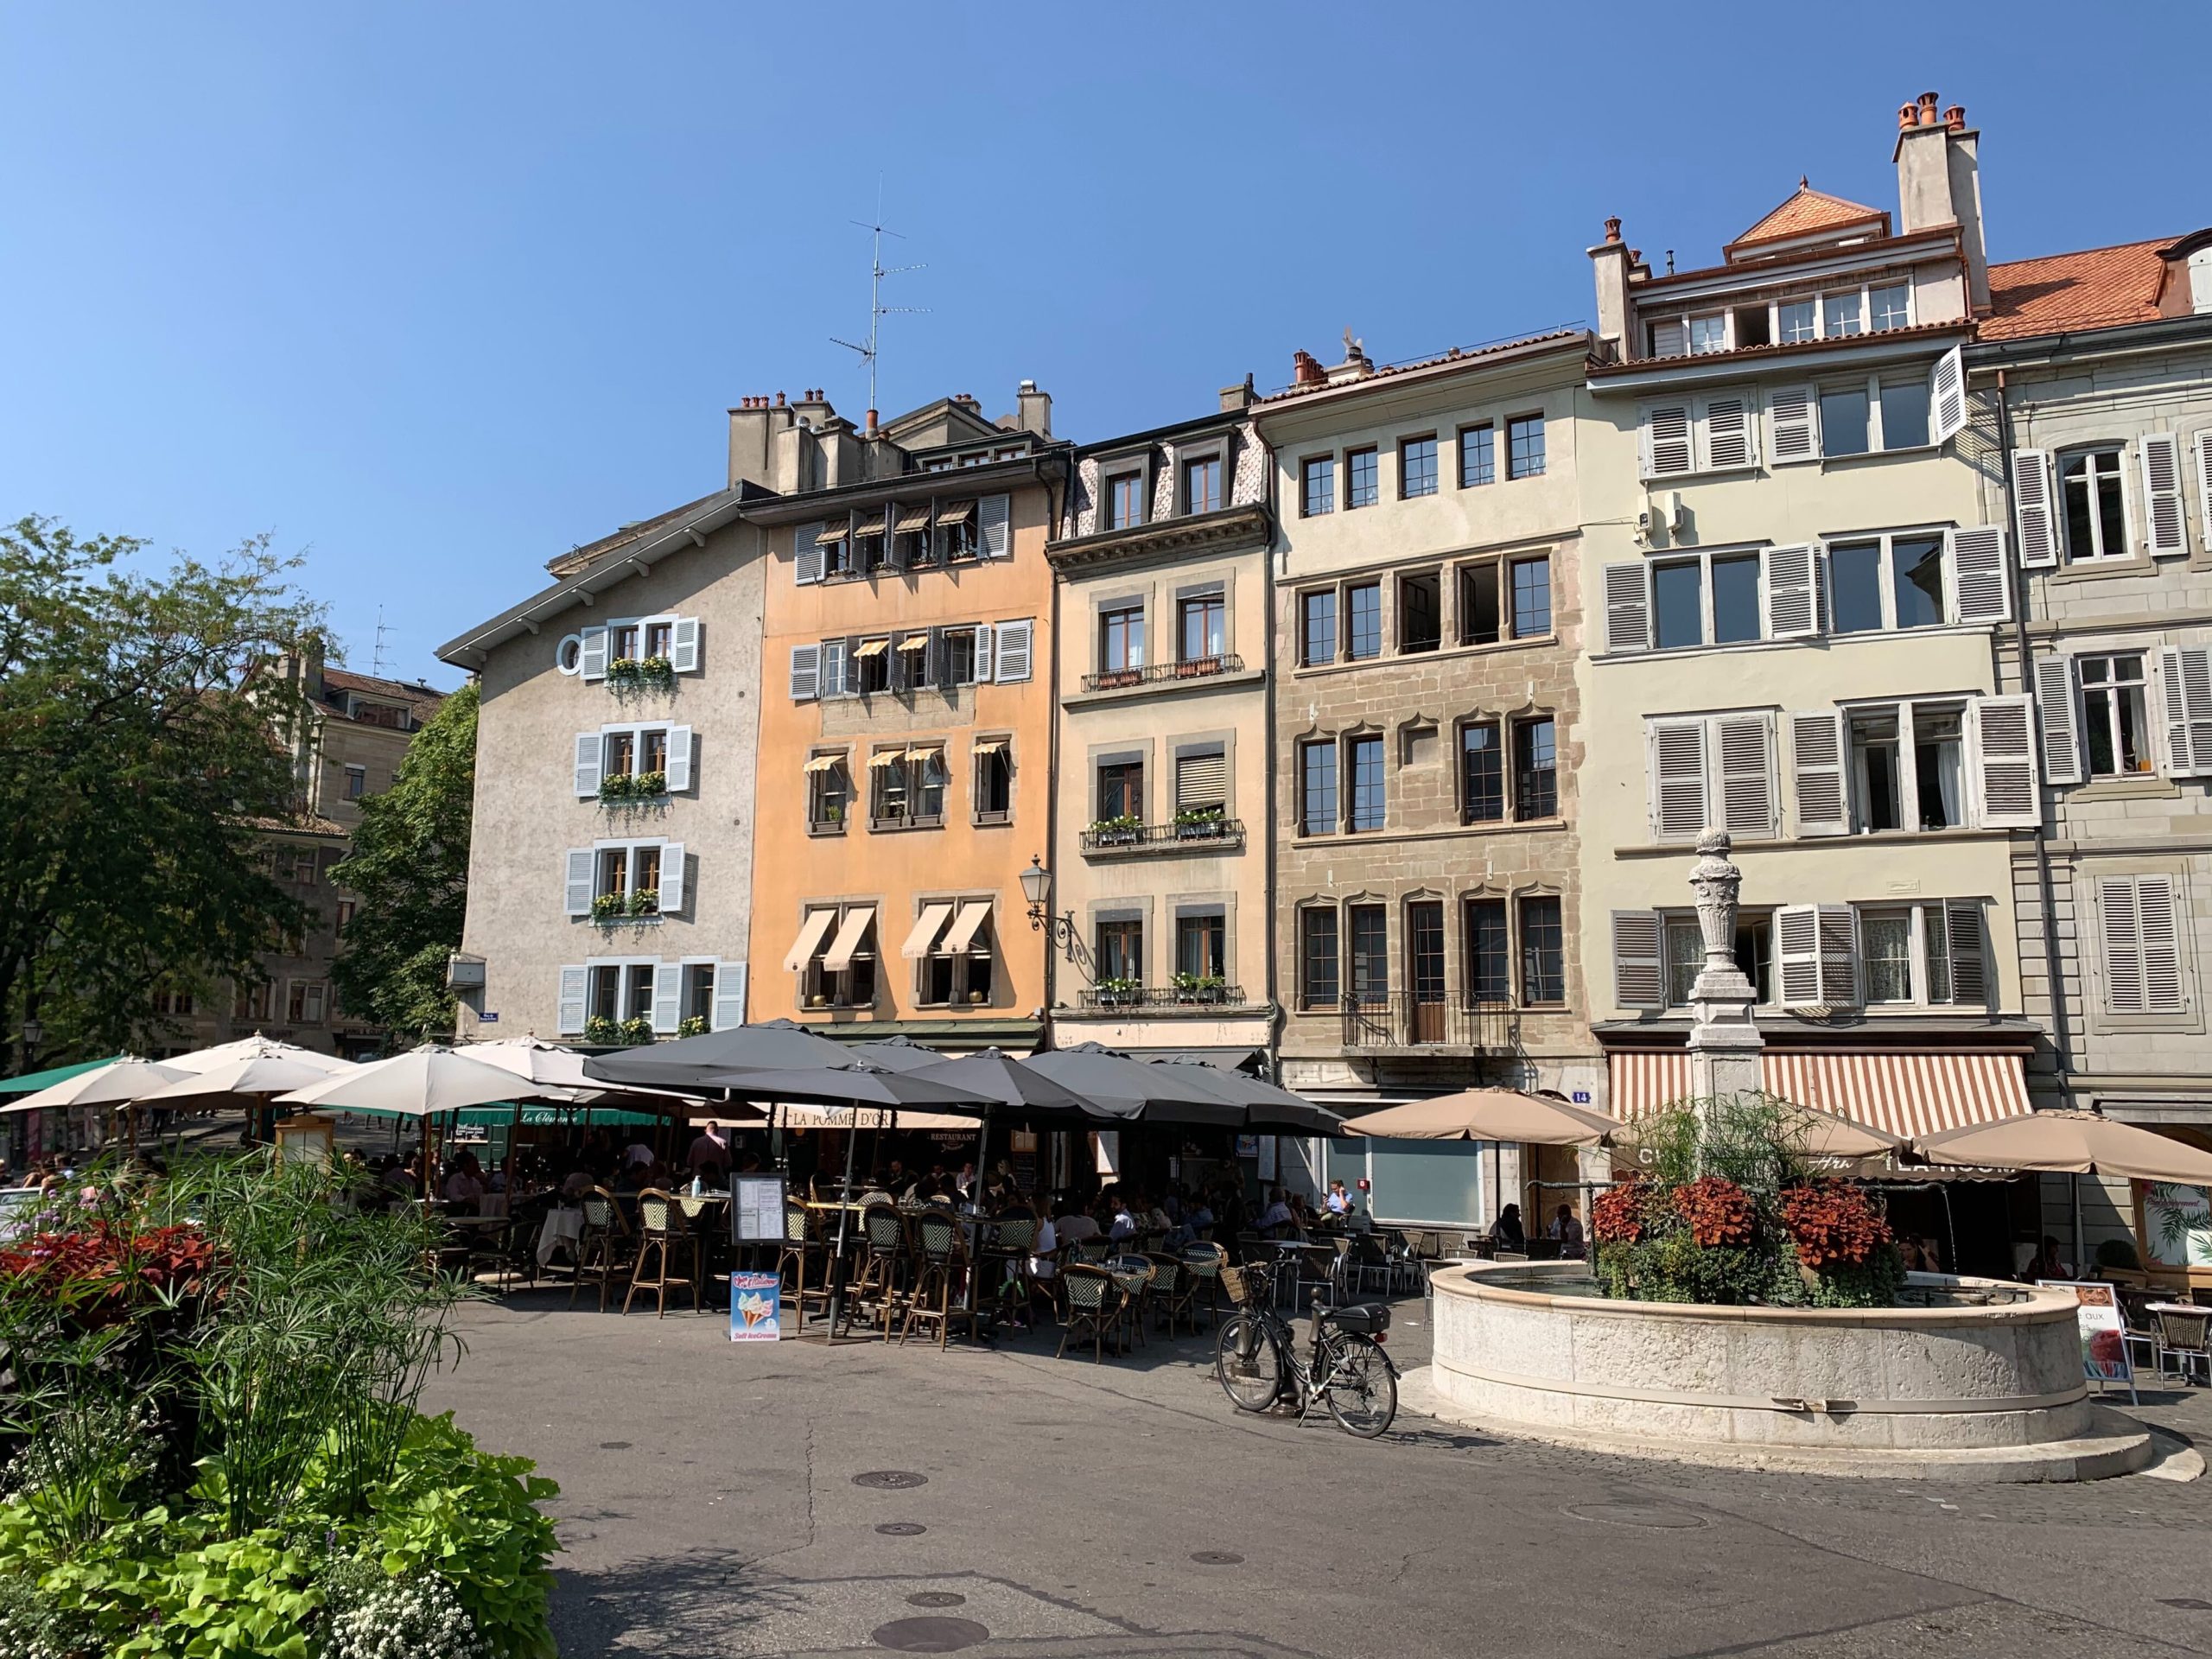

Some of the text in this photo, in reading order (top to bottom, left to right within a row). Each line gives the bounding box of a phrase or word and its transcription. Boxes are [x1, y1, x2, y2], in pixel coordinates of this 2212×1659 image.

[1576, 1093, 1587, 1102] 14
[520, 1112, 531, 1122] La
[794, 1113, 807, 1126] LA
[930, 1133, 976, 1141] RESTAURANT
